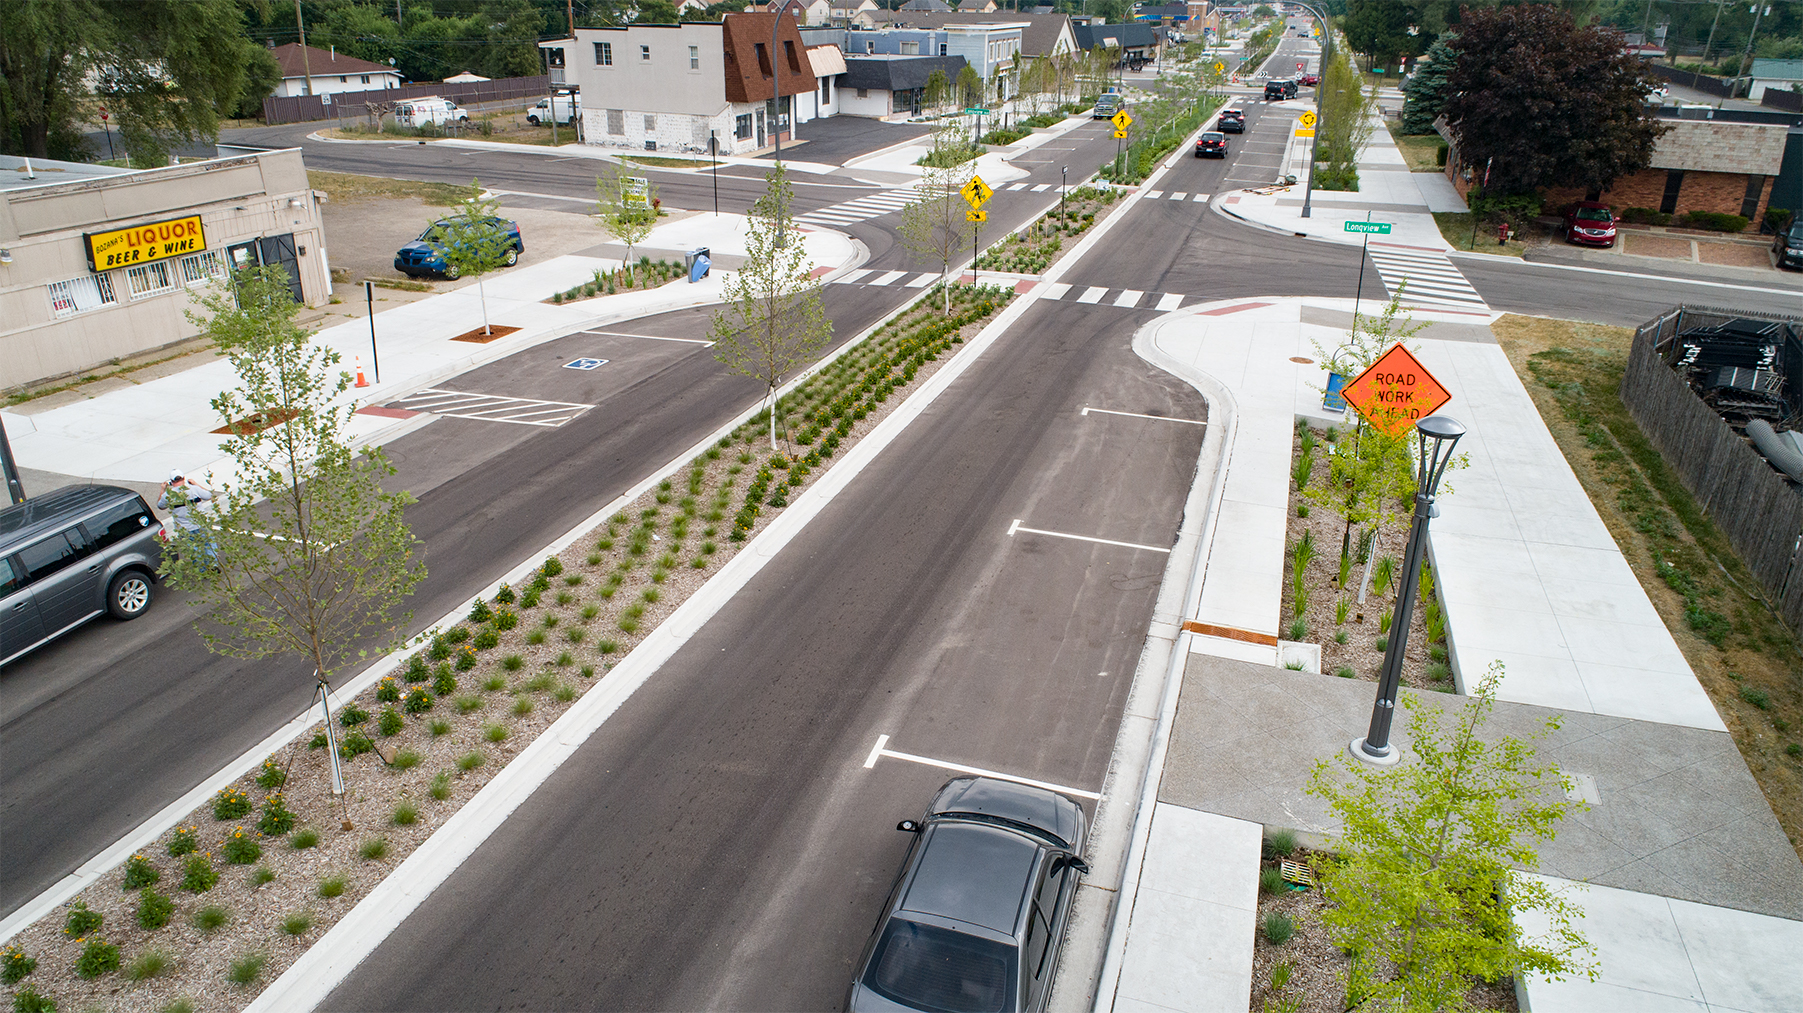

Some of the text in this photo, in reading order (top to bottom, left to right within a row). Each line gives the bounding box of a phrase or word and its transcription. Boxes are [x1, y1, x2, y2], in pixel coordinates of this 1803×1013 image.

[126, 221, 199, 248] LIQUOR
[1346, 222, 1380, 233] Longview
[95, 235, 124, 254] BOZANA'S
[106, 238, 195, 266] BEER & WINE
[1376, 373, 1416, 386] ROAD
[1375, 391, 1414, 403] WORK
